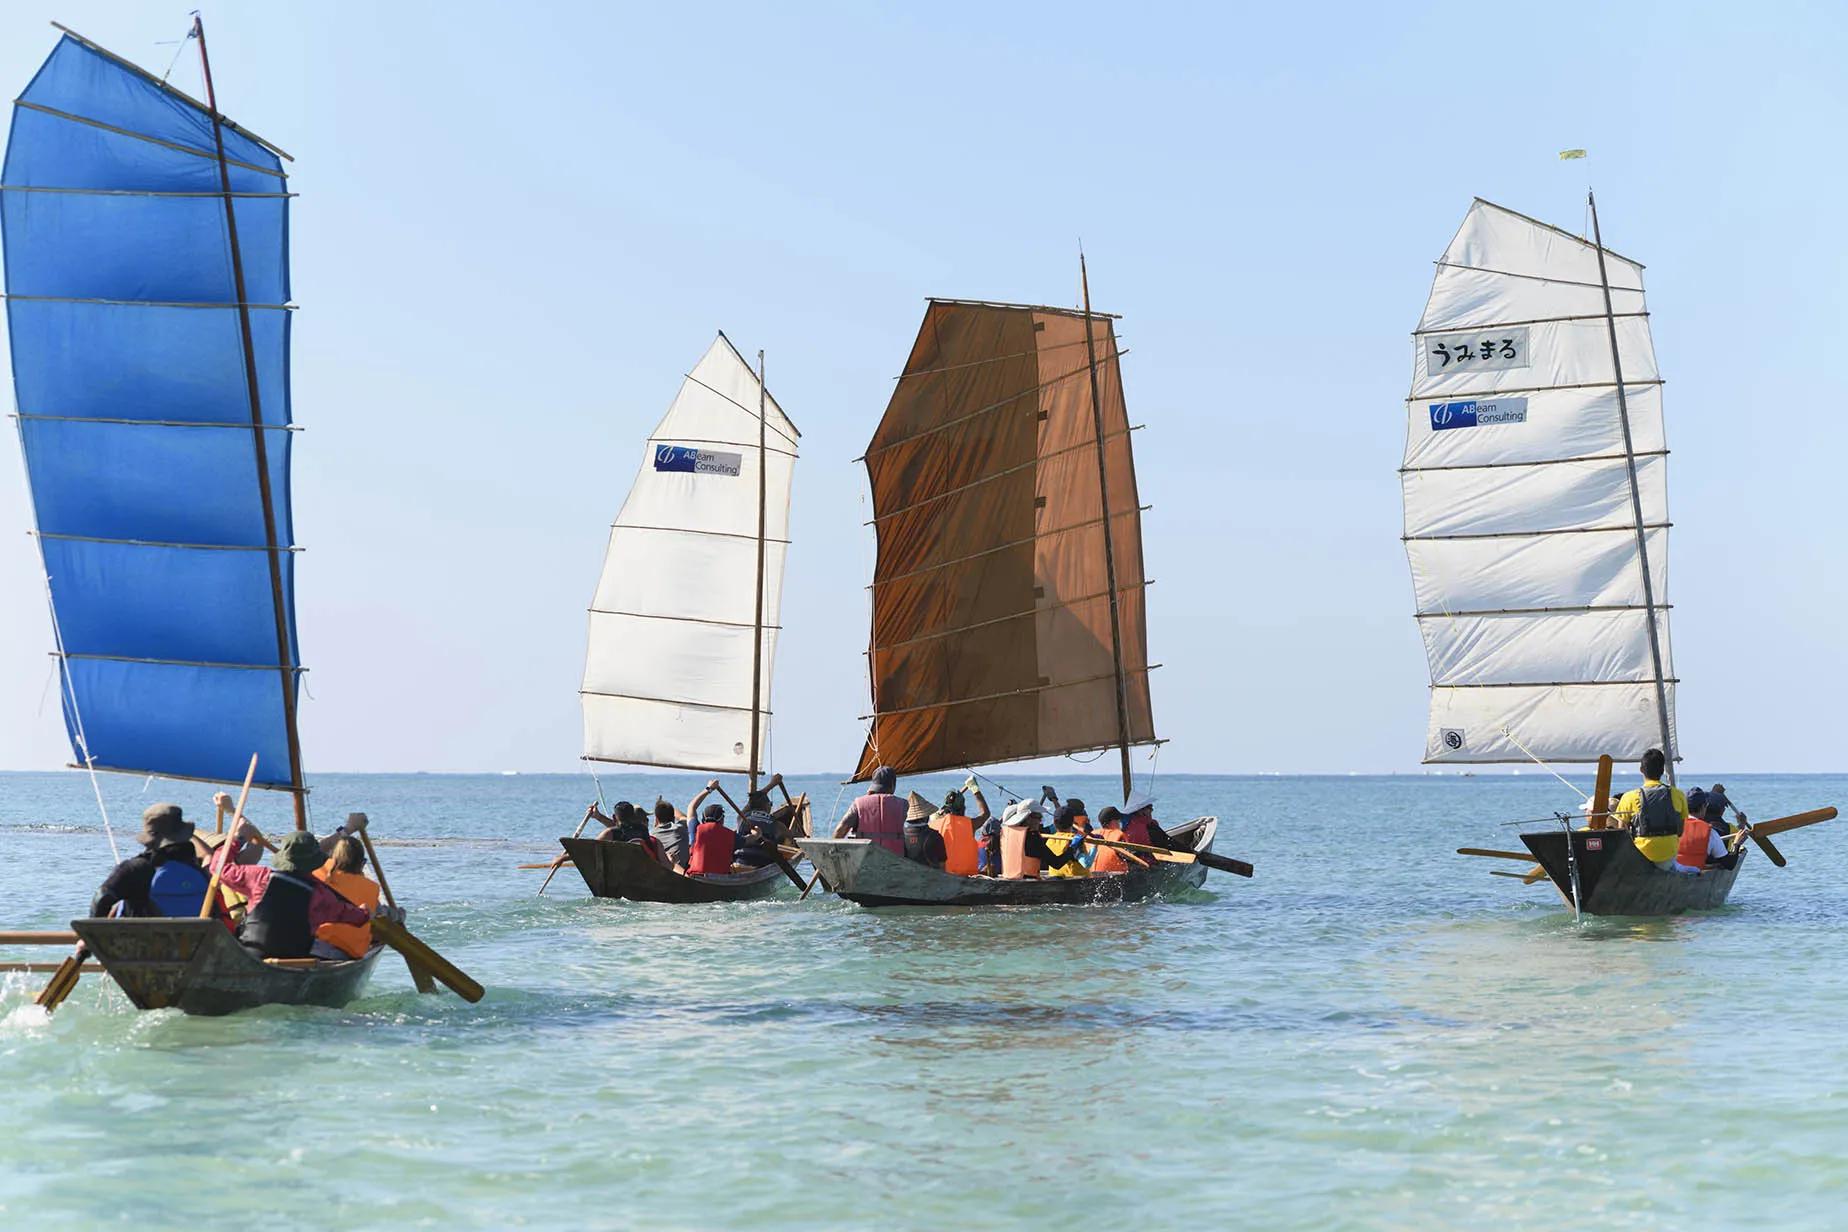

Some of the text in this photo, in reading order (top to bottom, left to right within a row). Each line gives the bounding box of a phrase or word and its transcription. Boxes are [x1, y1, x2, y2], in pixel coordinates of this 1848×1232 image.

[1432, 339, 1516, 367] うみまる
[1461, 403, 1497, 415] ABeam
[1477, 411, 1524, 424] Consulting
[683, 450, 715, 462] ABeam
[695, 461, 738, 477] Consulting
